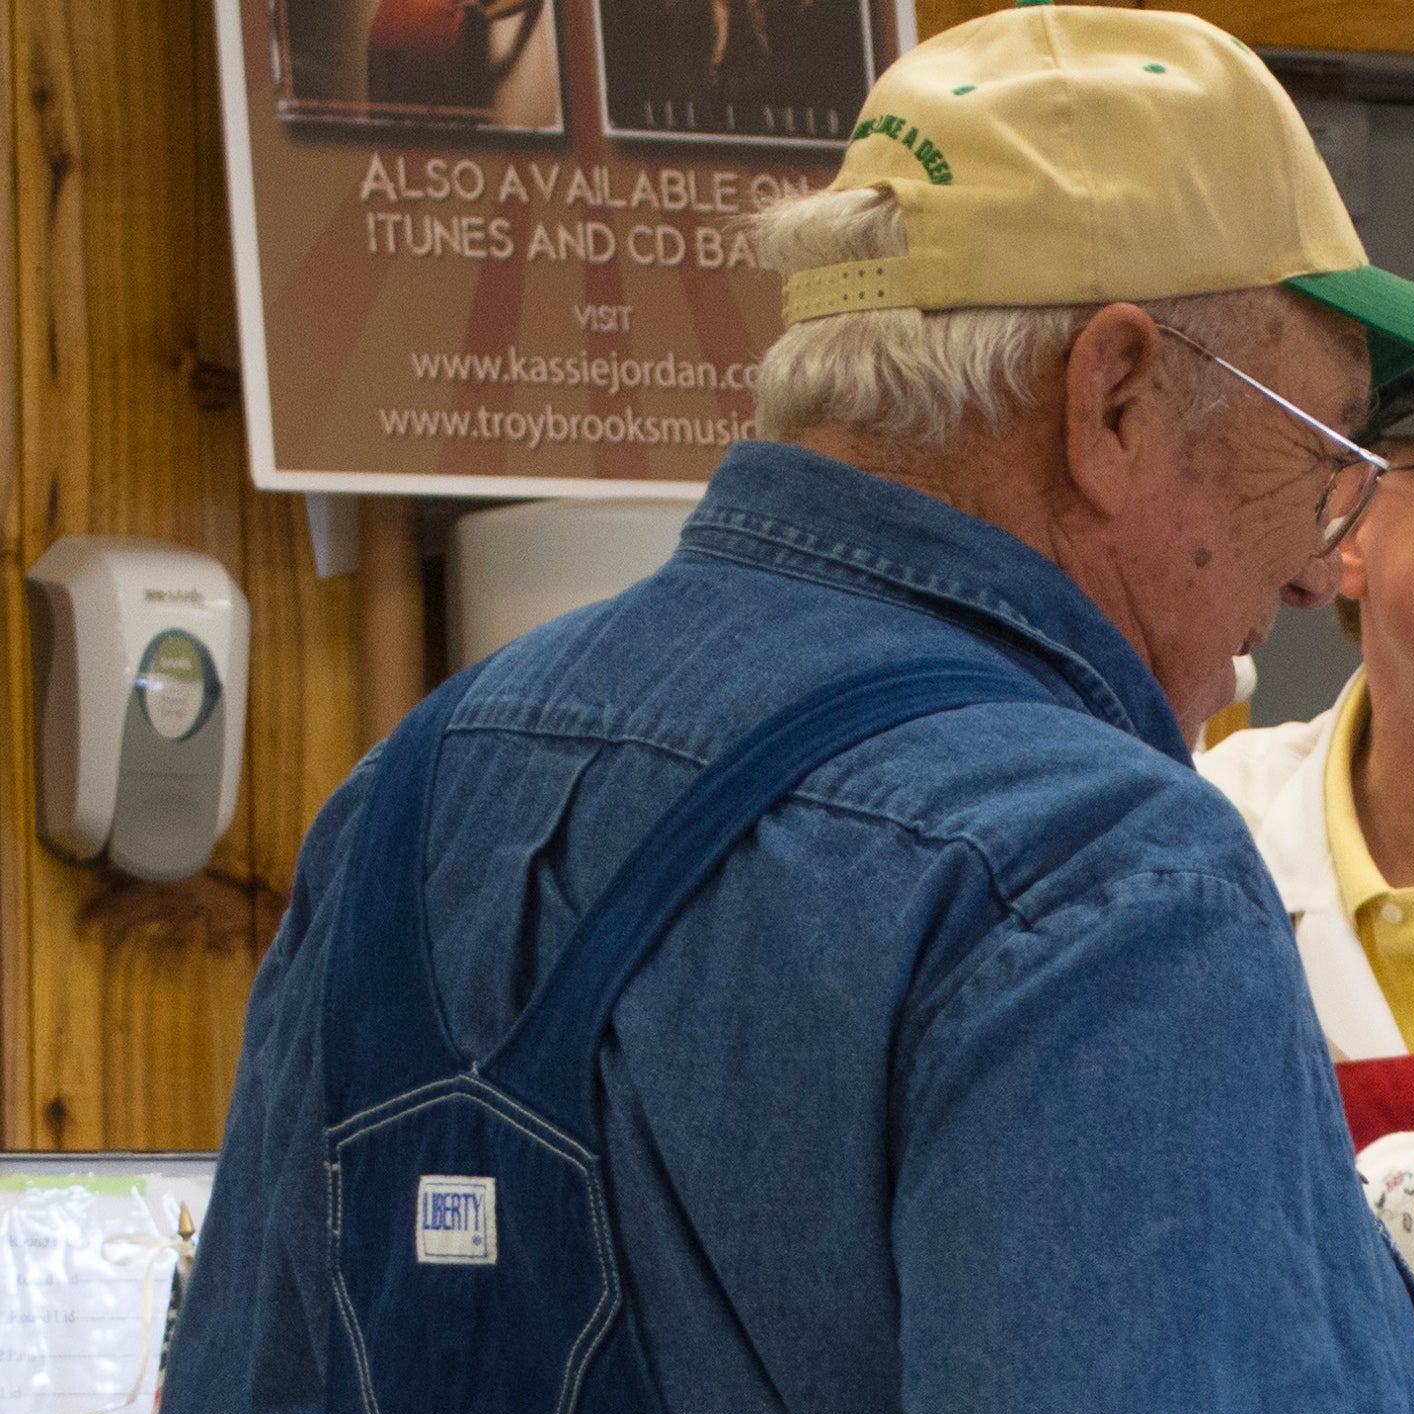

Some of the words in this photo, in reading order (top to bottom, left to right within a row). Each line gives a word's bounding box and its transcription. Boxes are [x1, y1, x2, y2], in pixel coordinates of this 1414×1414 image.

[360, 152, 486, 203] ALSO
[499, 161, 738, 213] AVAILABLE
[366, 211, 515, 262] ITUNES
[527, 220, 616, 266] AND
[627, 223, 687, 267] CD
[572, 303, 633, 333] VISIT
[422, 1191, 483, 1232] LIBERTY
